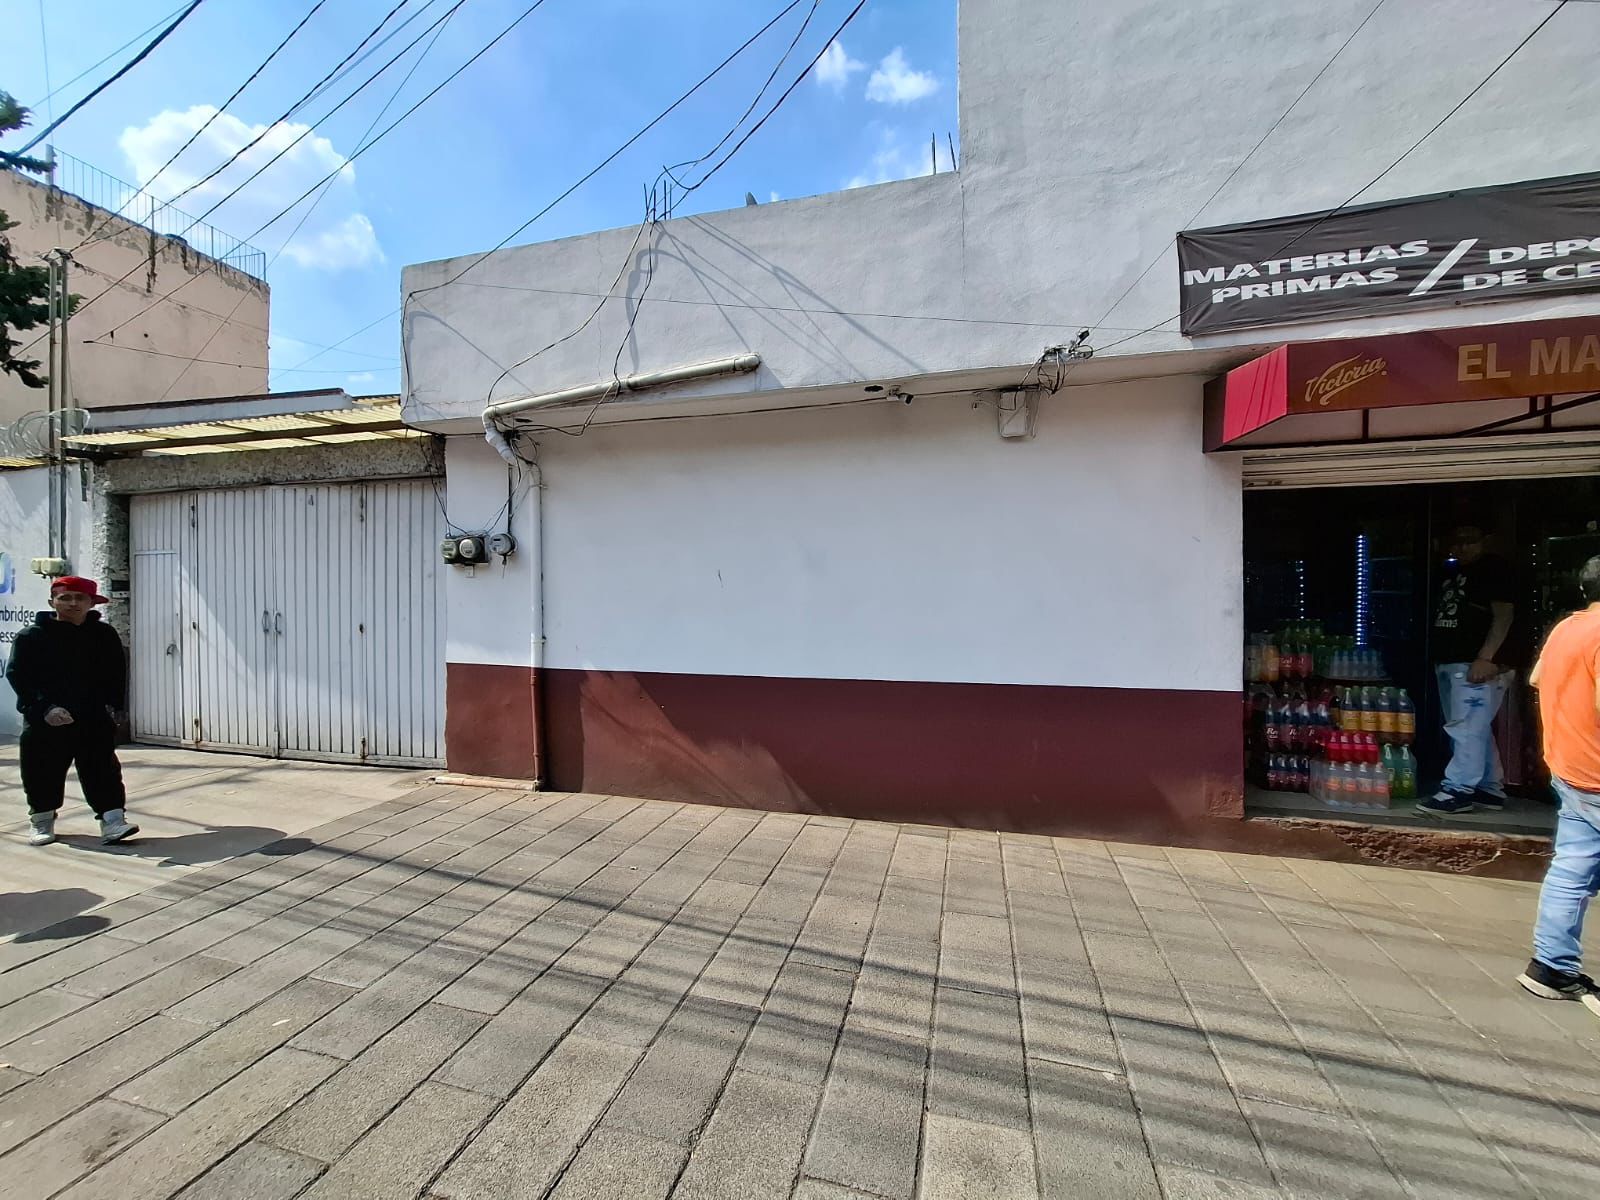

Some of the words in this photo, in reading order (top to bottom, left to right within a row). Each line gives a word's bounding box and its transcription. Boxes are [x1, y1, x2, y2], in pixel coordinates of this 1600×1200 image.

[1183, 239, 1430, 285] MATERIAS
[1212, 266, 1400, 304] PRIMAS
[1463, 268, 1529, 291] DE
[1304, 352, 1386, 406] Victoria
[1457, 342, 1512, 382] EL
[1529, 334, 1600, 377] MA
